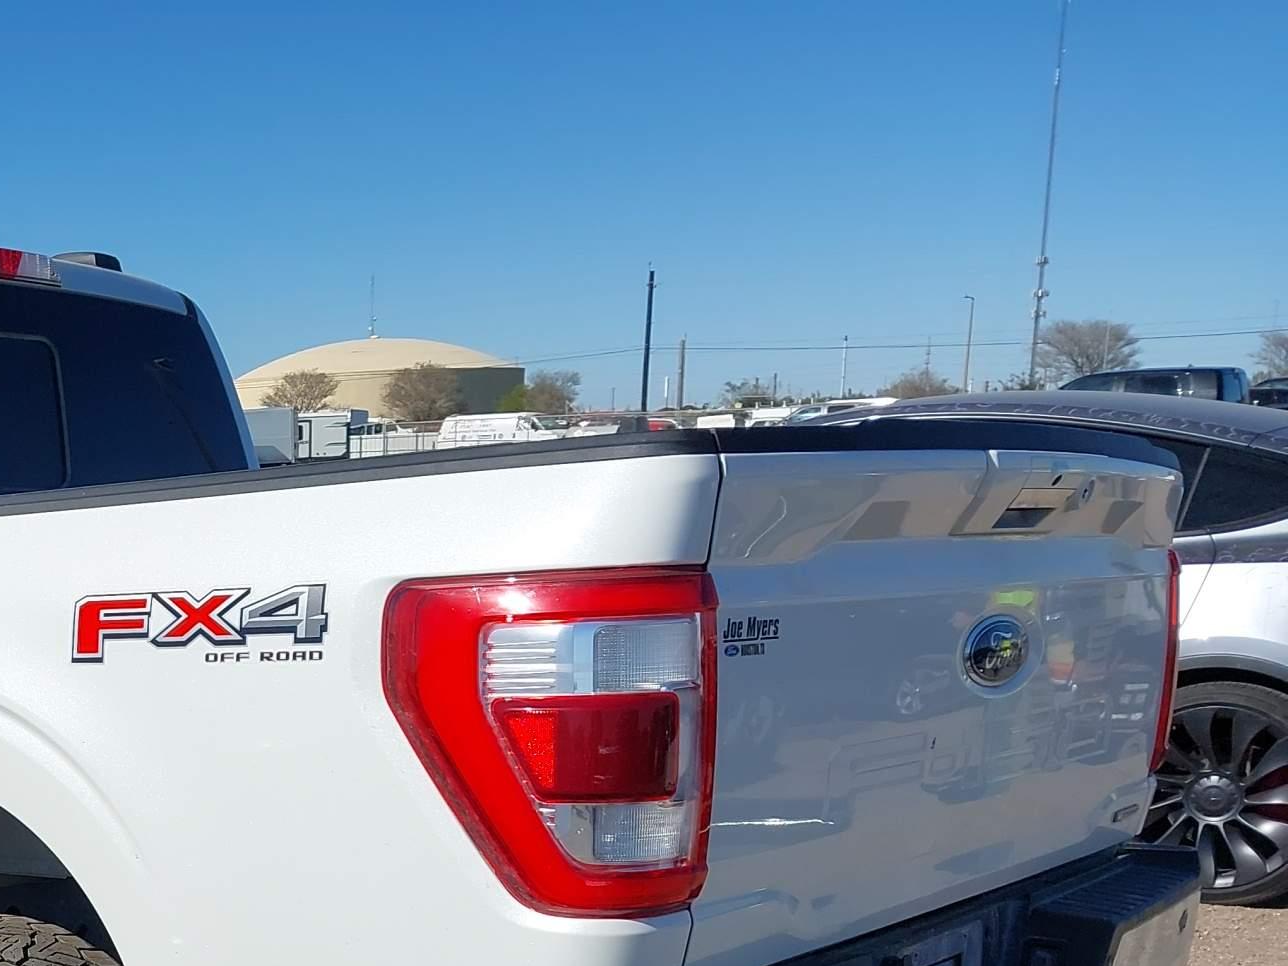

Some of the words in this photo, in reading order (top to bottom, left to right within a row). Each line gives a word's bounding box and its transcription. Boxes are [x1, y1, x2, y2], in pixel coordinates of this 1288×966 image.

[71, 583, 328, 663] FX4
[723, 617, 744, 640] Joe
[746, 616, 780, 640] Myers
[204, 650, 251, 663] OFF
[259, 650, 324, 662] ROAD
